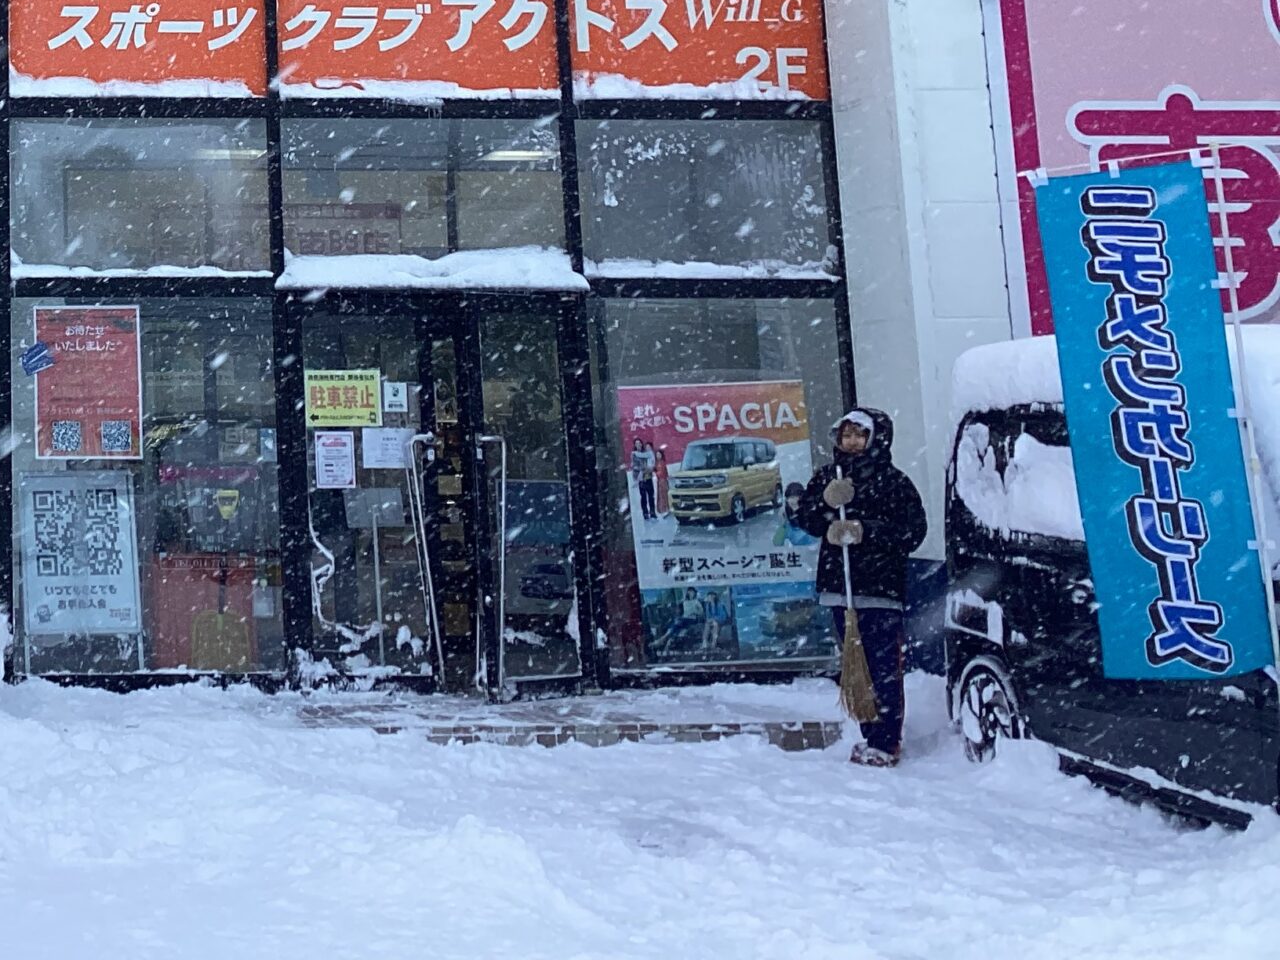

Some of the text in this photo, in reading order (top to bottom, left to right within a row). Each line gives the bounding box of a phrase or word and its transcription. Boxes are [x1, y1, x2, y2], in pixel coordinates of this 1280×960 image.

[735, 46, 809, 92] 2F
[55, 339, 117, 352] いたしました
[309, 384, 376, 409] 駐車禁止
[673, 402, 800, 433] SPACIA
